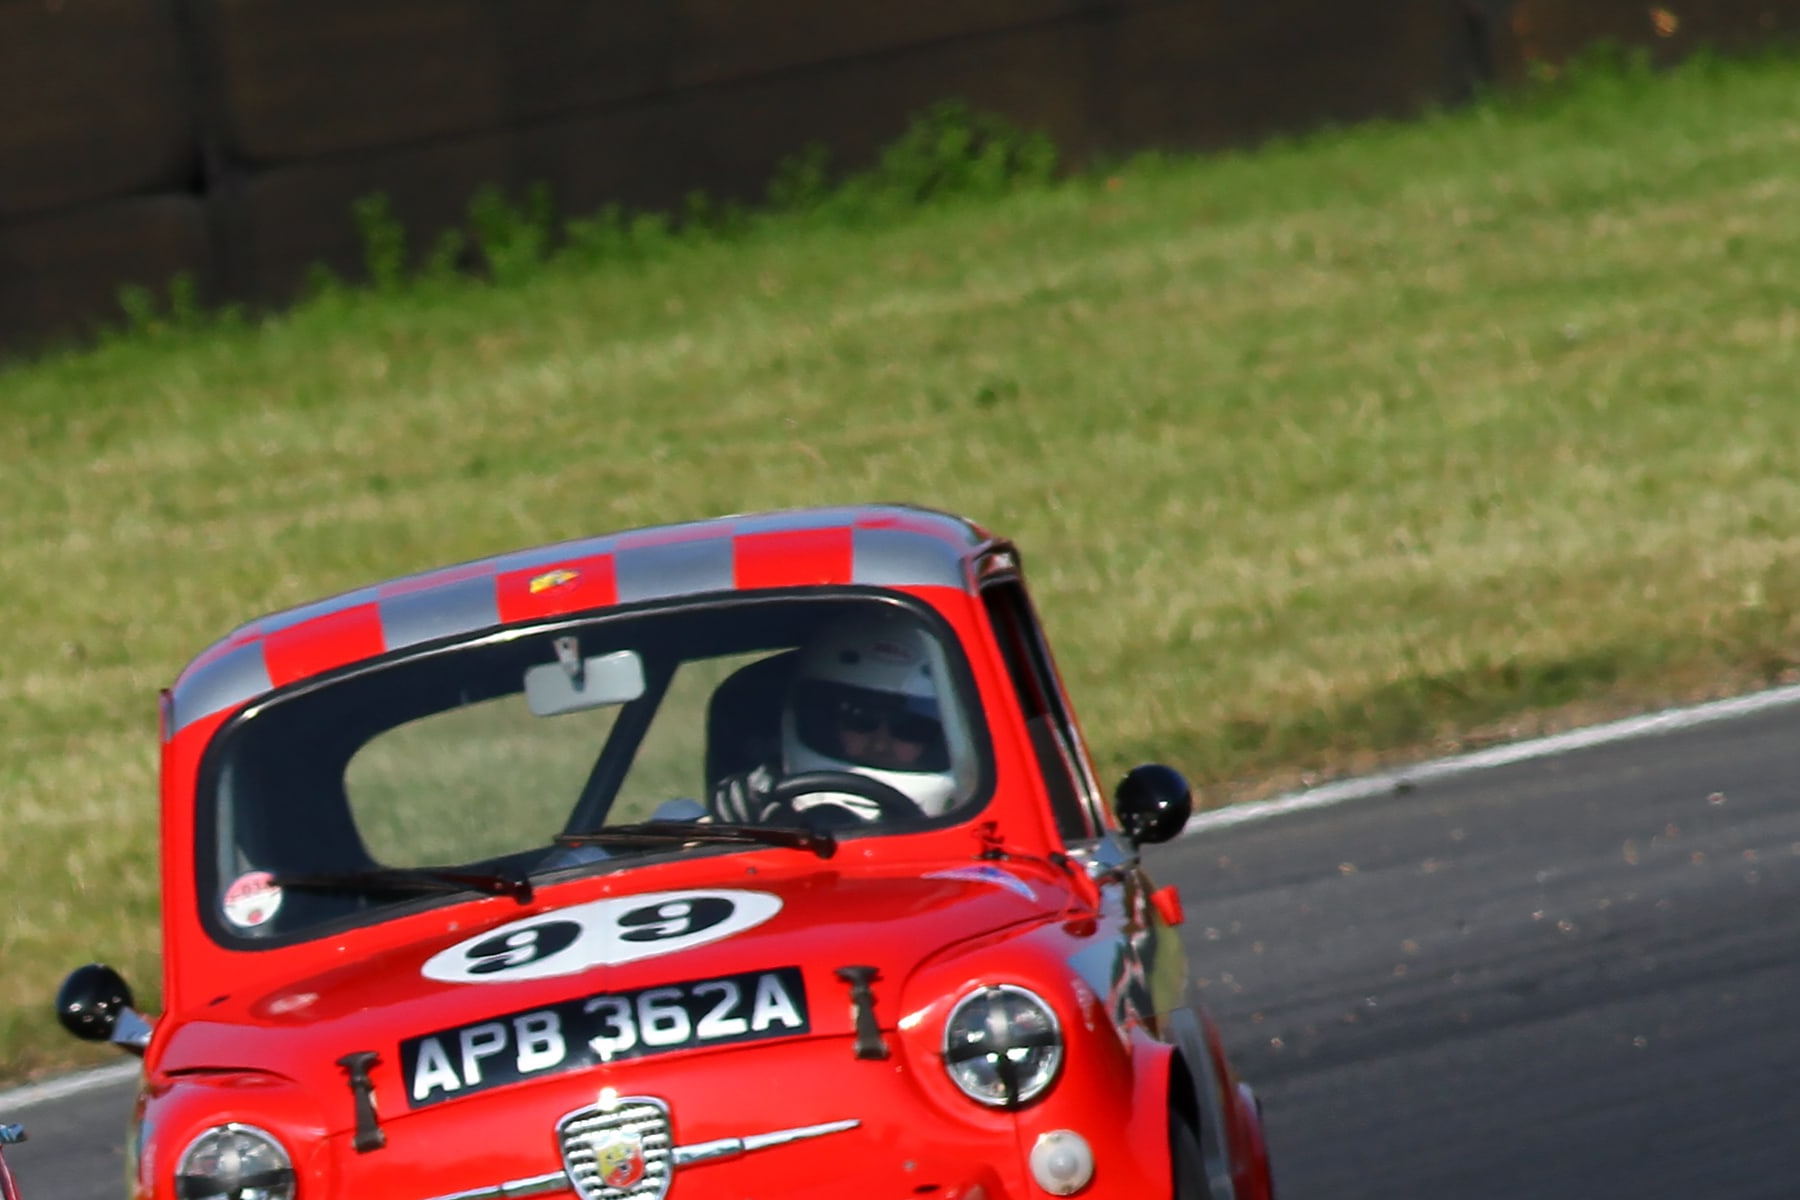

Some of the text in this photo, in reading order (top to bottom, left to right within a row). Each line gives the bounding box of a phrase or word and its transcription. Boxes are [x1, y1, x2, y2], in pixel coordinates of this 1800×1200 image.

[465, 897, 735, 975] 99
[413, 973, 802, 1101] APB 362A
